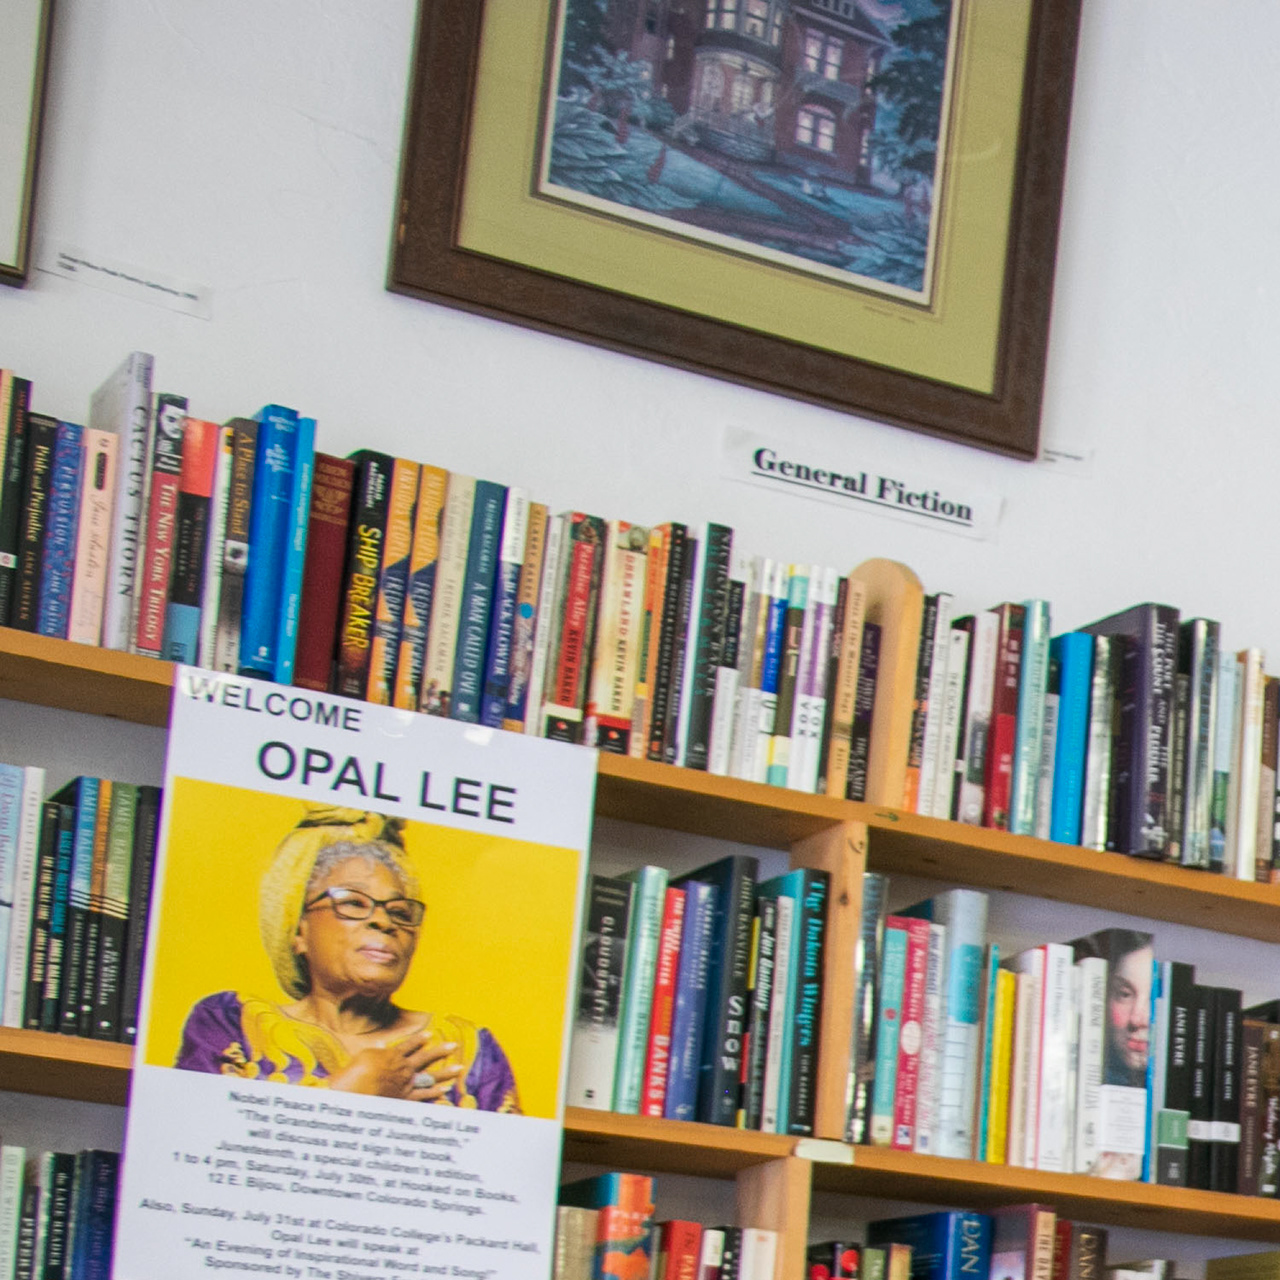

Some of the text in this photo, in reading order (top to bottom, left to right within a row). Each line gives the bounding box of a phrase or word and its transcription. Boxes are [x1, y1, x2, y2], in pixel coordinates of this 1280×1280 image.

[236, 444, 254, 479] Place
[118, 405, 148, 598] CACTUS THORN
[752, 447, 973, 521] General Fiction
[231, 498, 251, 536] Stand
[144, 483, 181, 642] THE NEW YORK TRILOGY
[574, 543, 594, 595] Paradise
[709, 533, 731, 634] NICHOLSON
[343, 523, 382, 650] SHIP BREAKER
[468, 594, 488, 623] MAN
[463, 626, 481, 668] CALLED
[493, 580, 517, 676] BLACK FLOWER
[565, 629, 580, 663] KEVIN
[610, 554, 636, 713] DREAMLAND KEVIN BAKER
[188, 674, 362, 733] WELCOME
[458, 671, 476, 697] OVE
[559, 666, 577, 704] BAKER
[256, 739, 517, 825] OPAL LEE
[115, 789, 131, 833] JAMES
[1172, 1006, 1188, 1066] JANE EYRE
[649, 1034, 668, 1099] BANKS
[1245, 1046, 1259, 1108] JANE EYRE
[227, 1091, 272, 1106] Nobel
[271, 1096, 317, 1112] Peace
[317, 1102, 355, 1118] Prize
[420, 1116, 454, 1132] Opal
[454, 1122, 482, 1134] Lee
[275, 1113, 363, 1135] Grandmother
[367, 1126, 383, 1138] of
[247, 1127, 273, 1140] will
[273, 1130, 330, 1147] discuss
[331, 1139, 360, 1151] and
[360, 1144, 392, 1158] sign
[393, 1146, 419, 1158] her
[299, 1152, 312, 1161] a
[312, 1152, 364, 1170] special
[172, 1151, 181, 1161] 1
[183, 1153, 200, 1164] to
[200, 1154, 213, 1165] 4
[313, 1169, 344, 1184] July
[382, 1178, 398, 1189] at
[398, 1180, 452, 1195] Hooked
[453, 1188, 472, 1197] on
[207, 1172, 226, 1184] 12
[288, 1181, 364, 1201] Downtown
[364, 1191, 429, 1208] Colorado
[17, 1217, 36, 1267] PETER
[241, 1210, 272, 1226] July
[274, 1213, 306, 1227] 31st
[306, 1218, 323, 1229] at
[323, 1218, 389, 1237] Colorado
[454, 1233, 510, 1250] Packard
[269, 1229, 420, 1257] Opal Lee will speak at
[958, 1218, 982, 1273] DAN
[203, 1255, 284, 1277] Sponsored
[283, 1265, 304, 1279] by
[306, 1266, 334, 1280] The
[214, 1239, 275, 1260] Evening
[275, 1247, 293, 1259] of
[293, 1249, 381, 1271] Inspirational
[382, 1259, 421, 1272] Word
[421, 1263, 449, 1276] and
[1078, 1233, 1098, 1278] DAN
